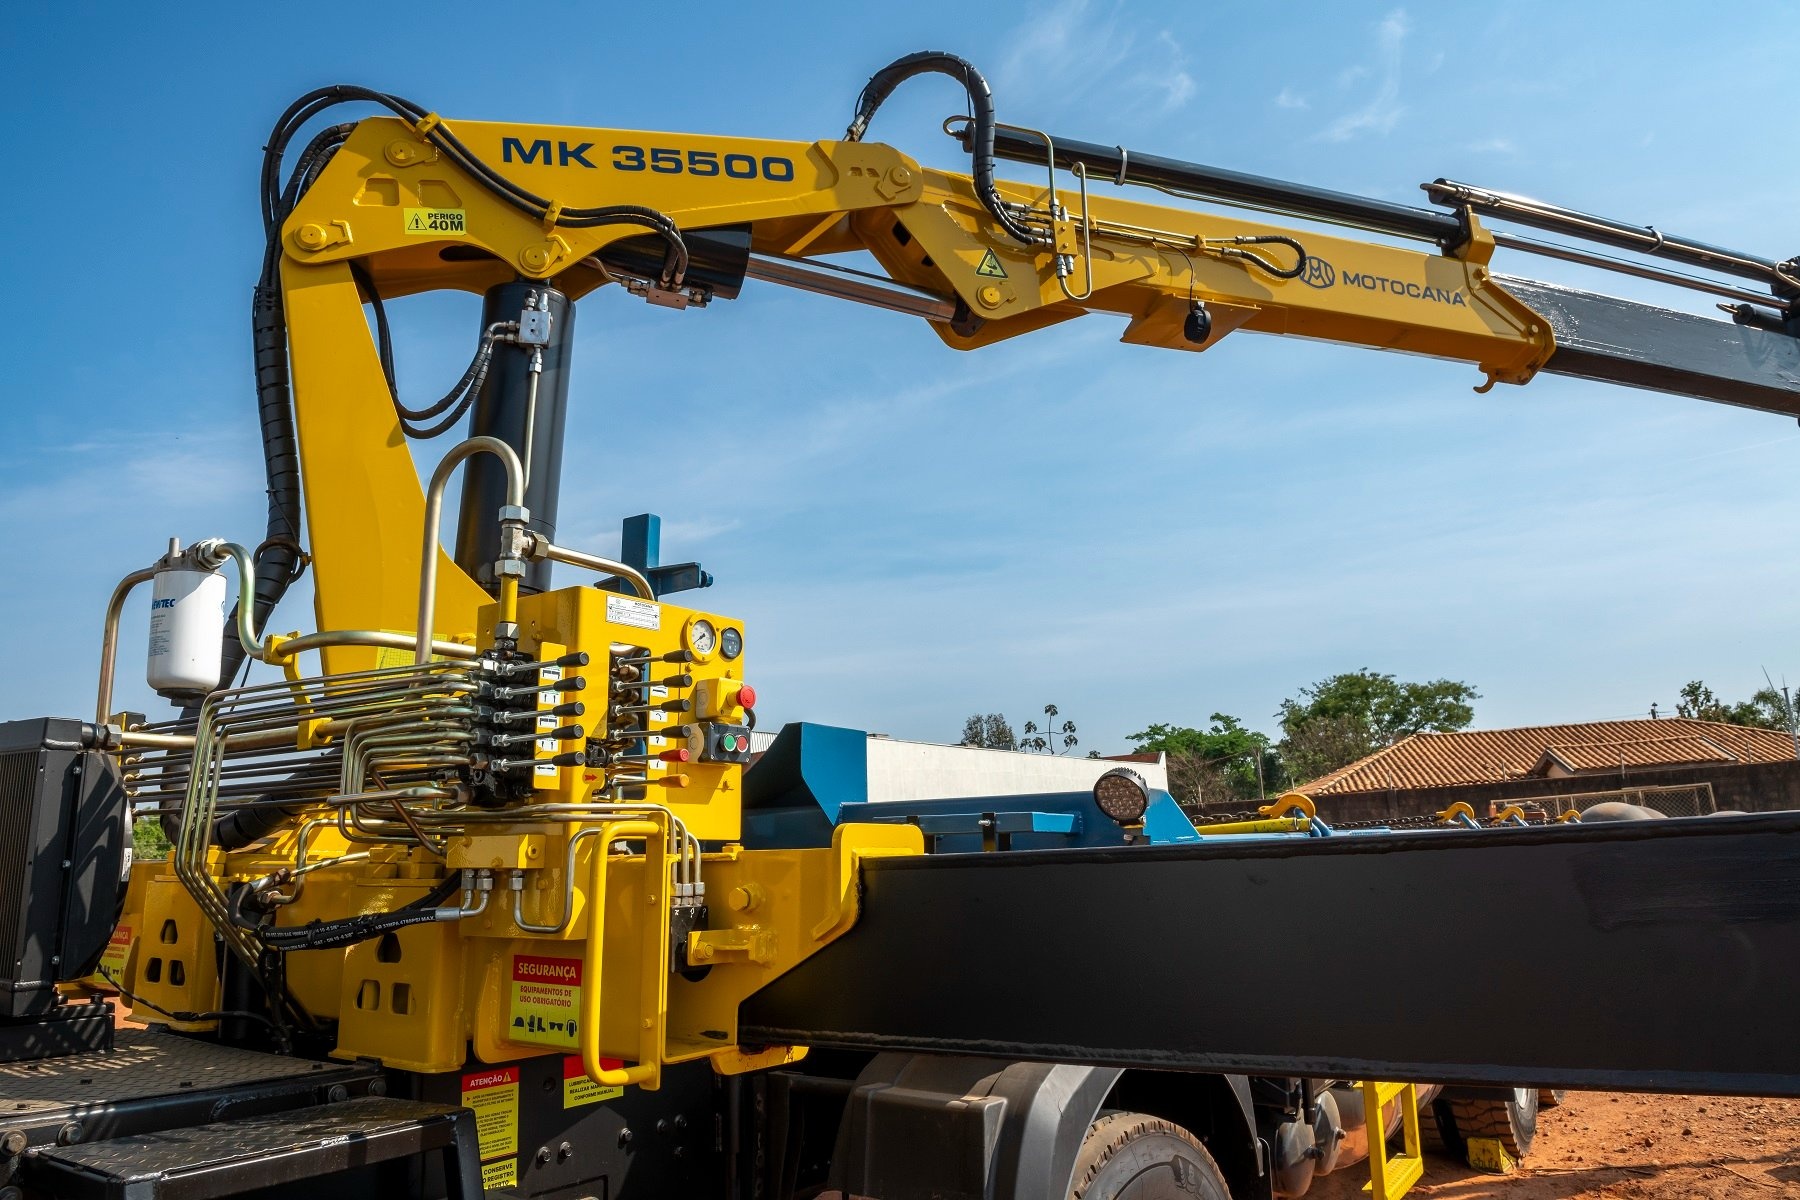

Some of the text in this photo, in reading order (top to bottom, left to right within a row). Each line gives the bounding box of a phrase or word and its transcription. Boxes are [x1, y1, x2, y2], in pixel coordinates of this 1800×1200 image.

[502, 137, 795, 182] MK 35500
[429, 220, 464, 231] 40M
[1342, 270, 1467, 307] MOTOCANA
[518, 962, 577, 981] SEGURANÇA
[520, 985, 572, 997] EQUIPAMENTOS DE
[519, 995, 572, 1007] USO OBRIGATÓRIO
[470, 1074, 503, 1088] ATENÇÃO
[569, 1085, 590, 1095] REALIZAR
[573, 1088, 615, 1101] CONFORME MANUAL
[483, 1162, 513, 1175] CONSERVE
[487, 1169, 514, 1183] REGISTRO
